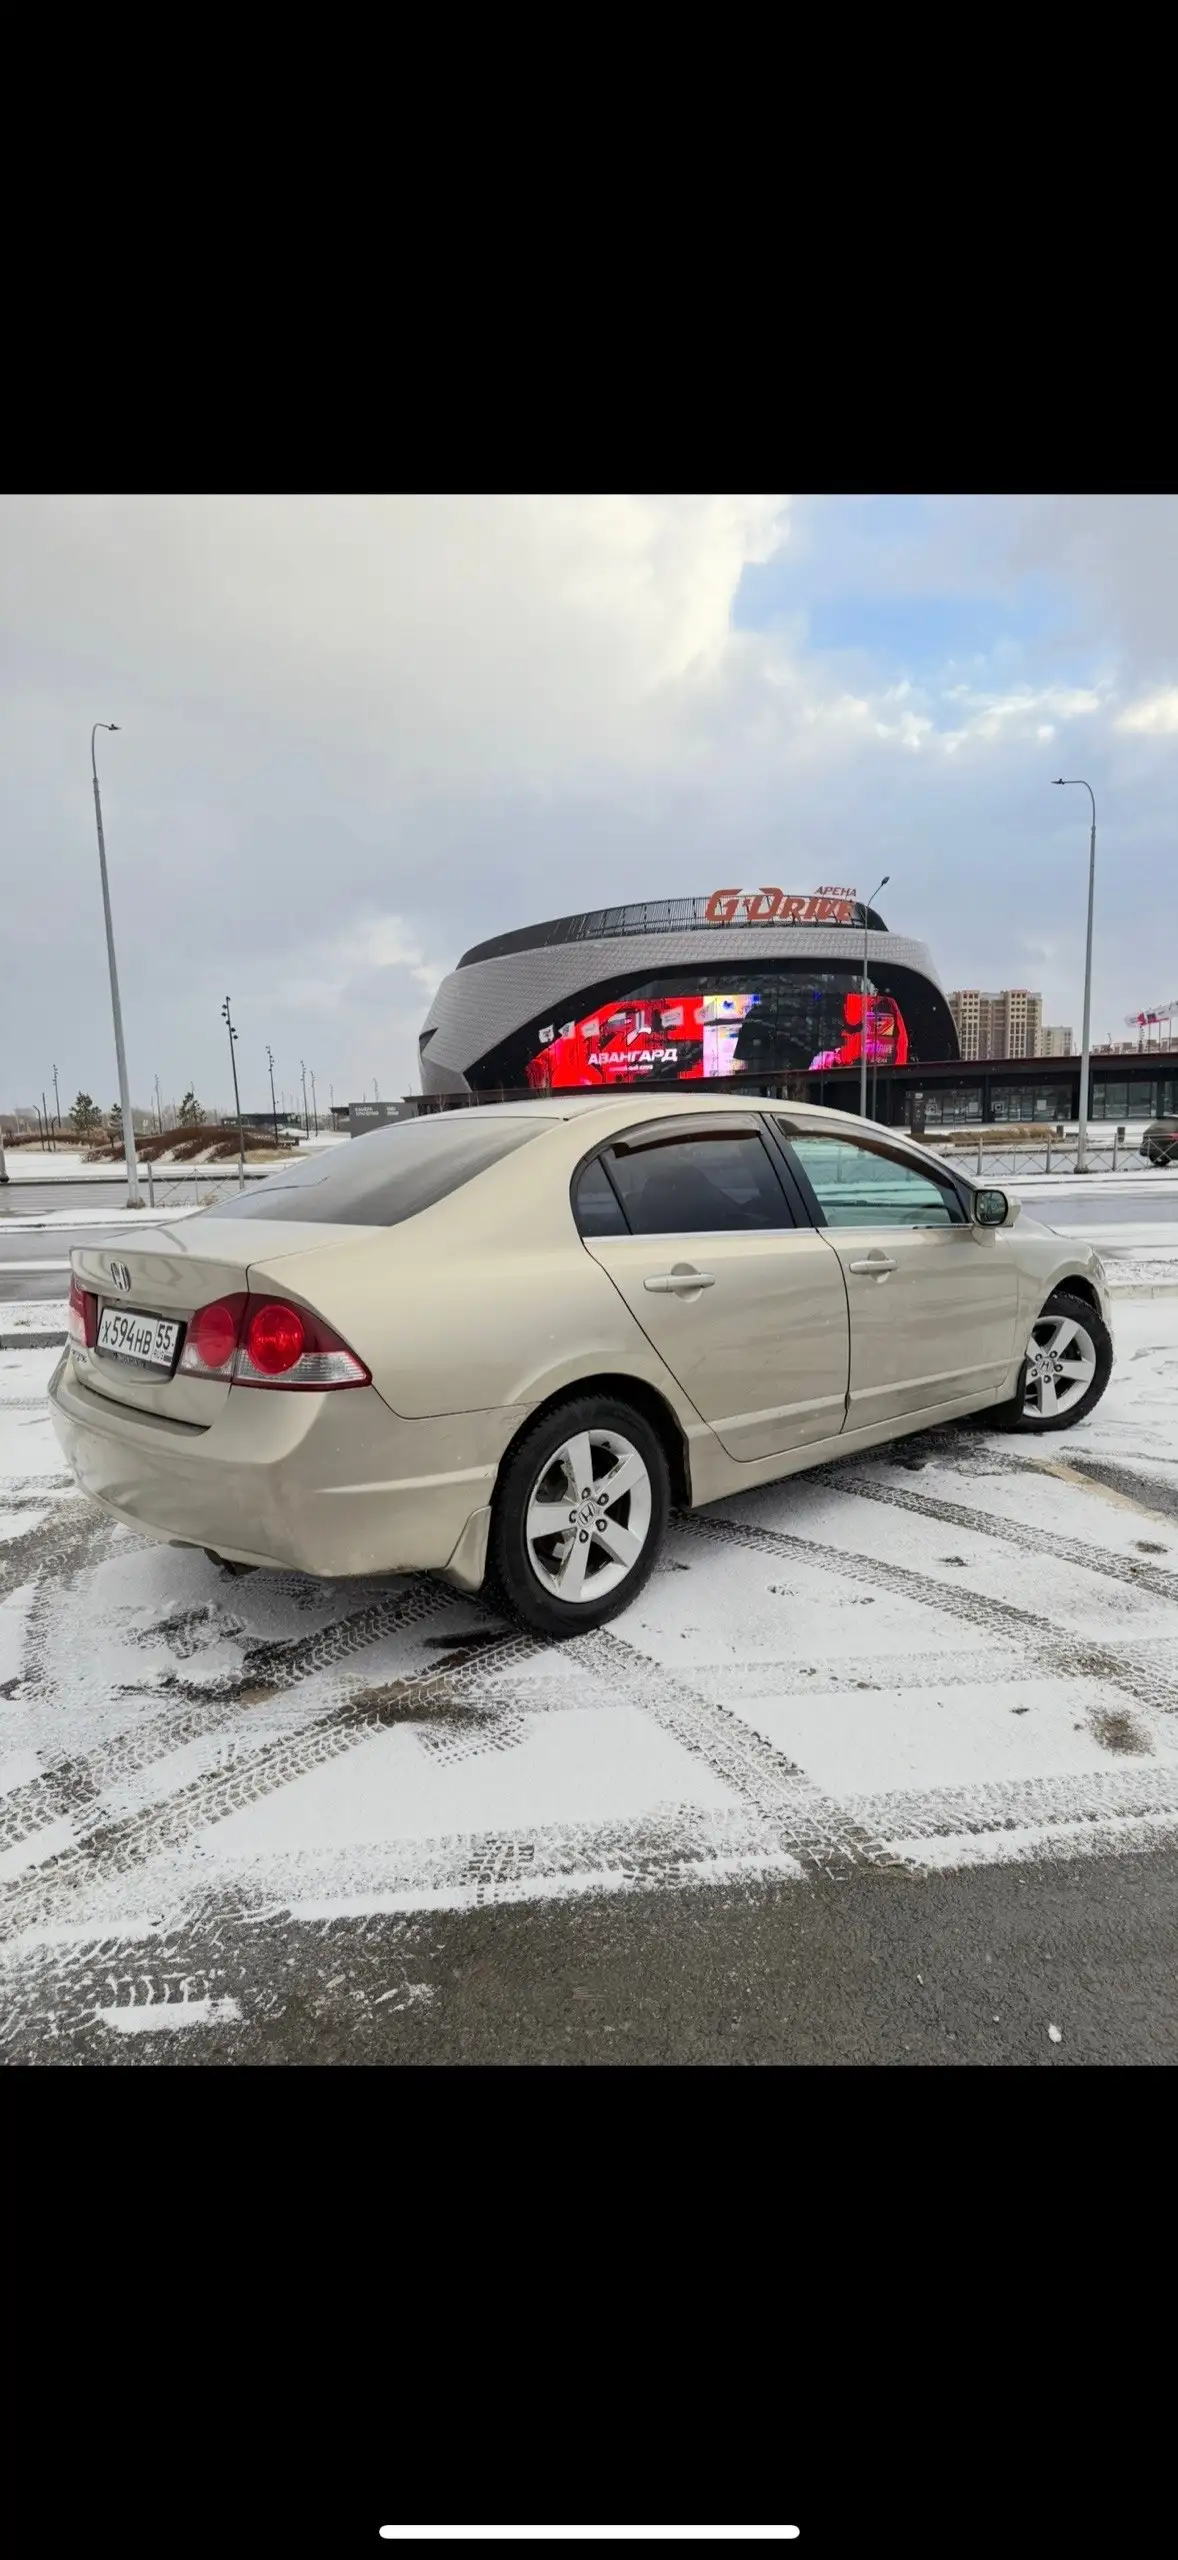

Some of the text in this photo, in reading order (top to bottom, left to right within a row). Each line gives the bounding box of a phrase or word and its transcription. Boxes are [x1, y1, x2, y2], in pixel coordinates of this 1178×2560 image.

[814, 885, 857, 898] АРЕНА
[588, 1048, 678, 1066] АВАНГАРД
[156, 1324, 173, 1350] 55
